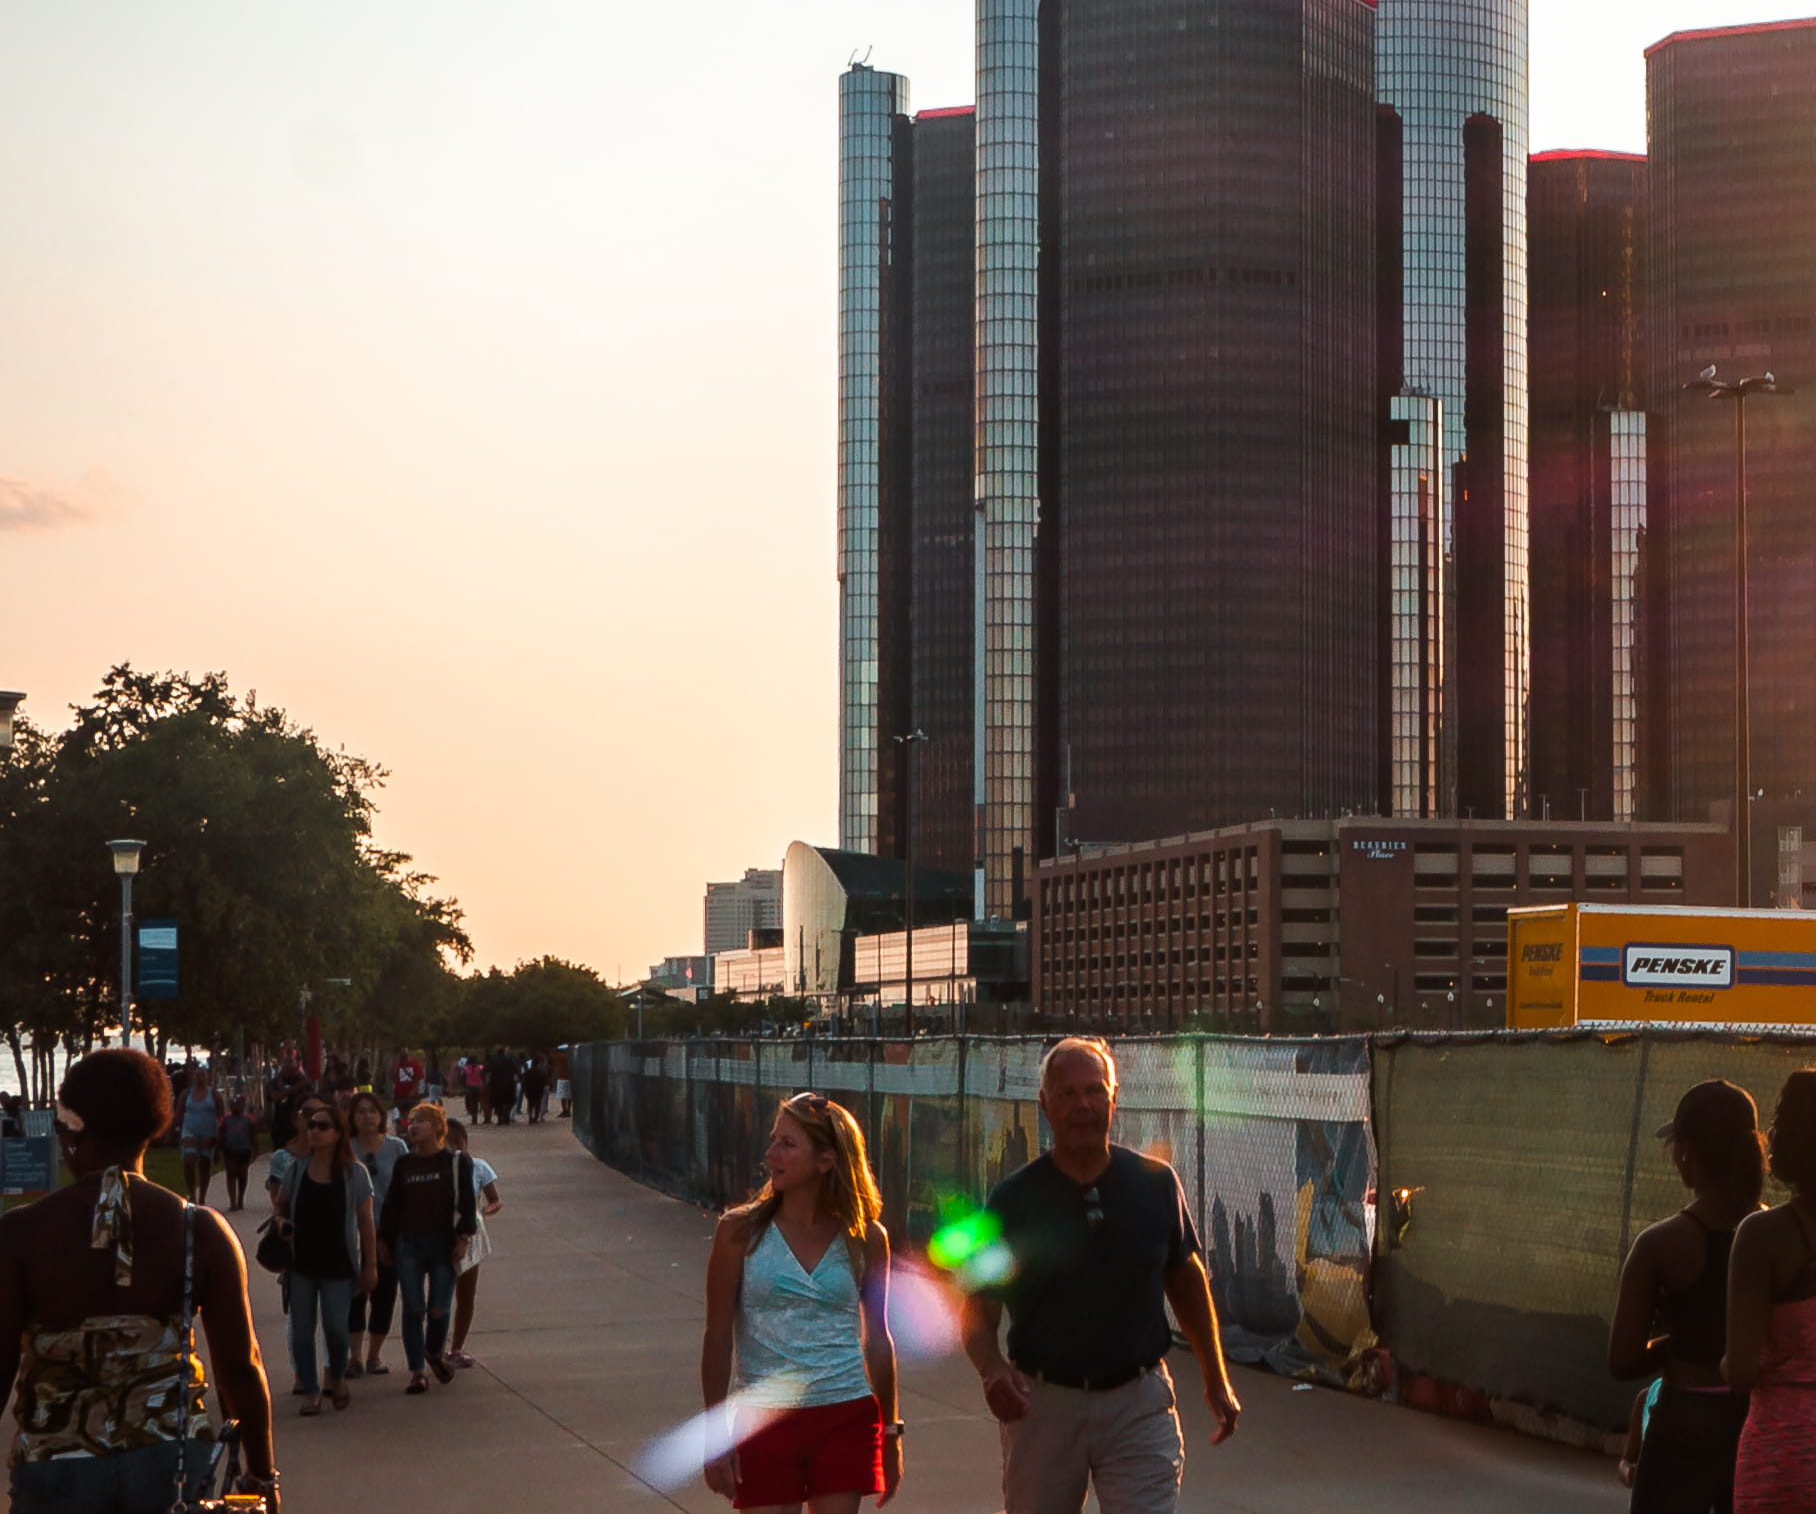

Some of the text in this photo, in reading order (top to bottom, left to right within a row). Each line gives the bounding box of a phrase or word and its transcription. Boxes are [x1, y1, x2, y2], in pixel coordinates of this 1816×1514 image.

[1521, 943, 1564, 963] PENSKE
[1630, 957, 1727, 975] PENSKE
[1644, 990, 1716, 1004] Truck Rental
